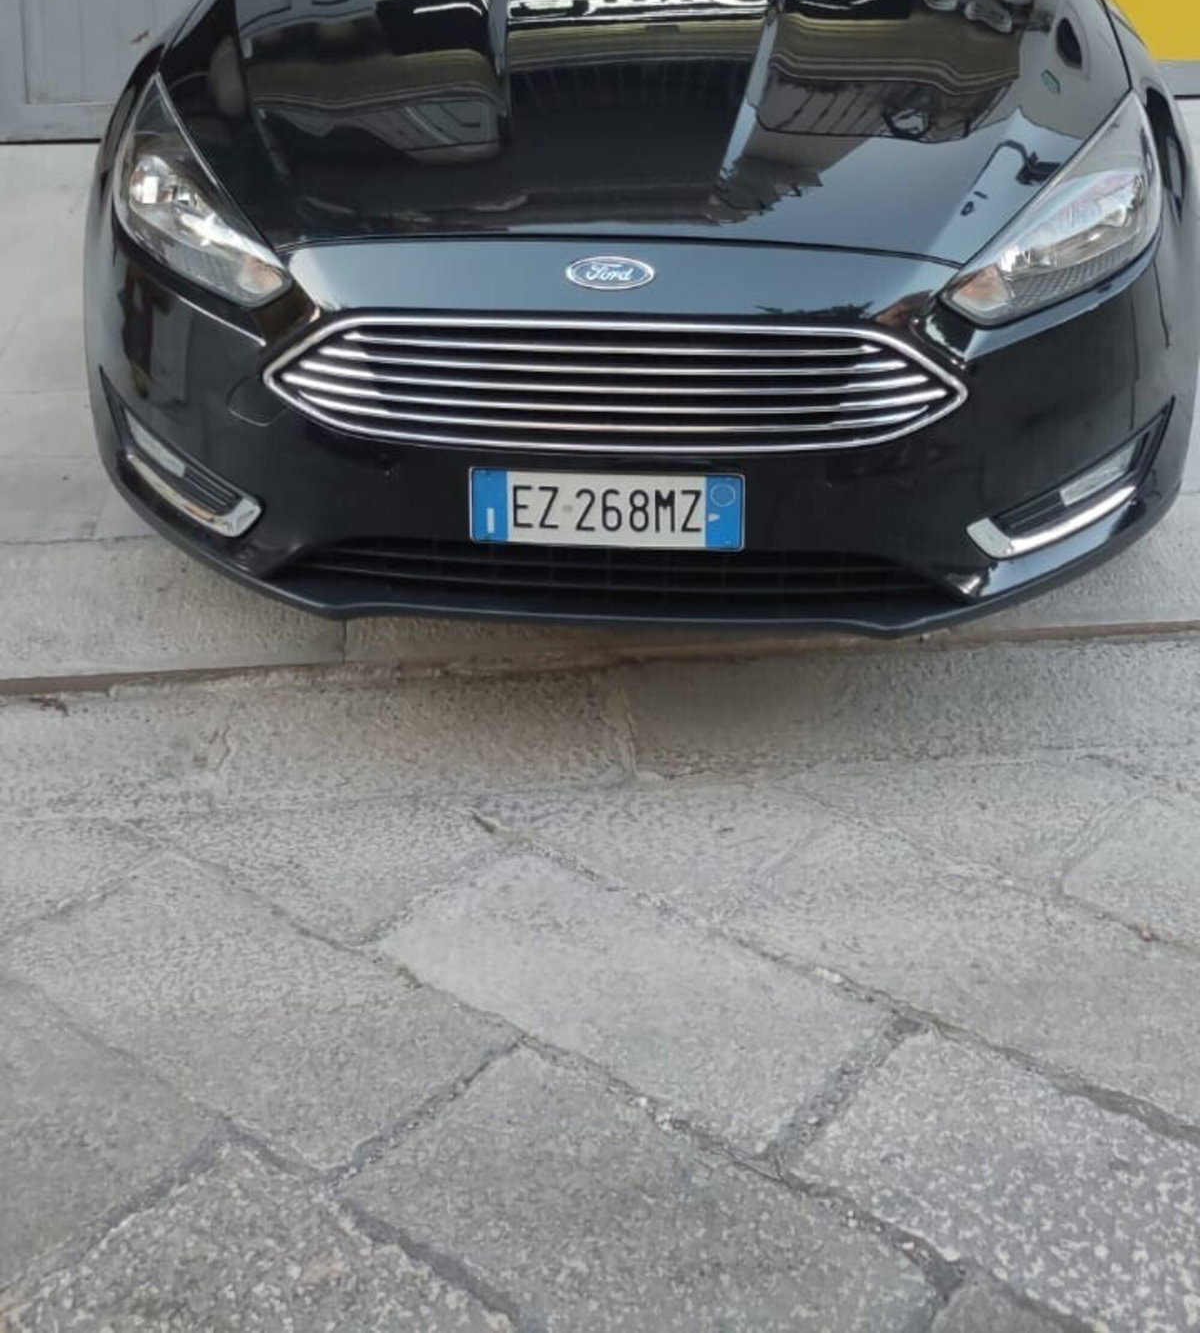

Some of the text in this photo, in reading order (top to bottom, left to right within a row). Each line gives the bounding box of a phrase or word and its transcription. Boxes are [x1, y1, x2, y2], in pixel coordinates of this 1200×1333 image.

[585, 262, 635, 281] Ford
[512, 485, 560, 530] EZ
[575, 487, 703, 533] 268MZ
